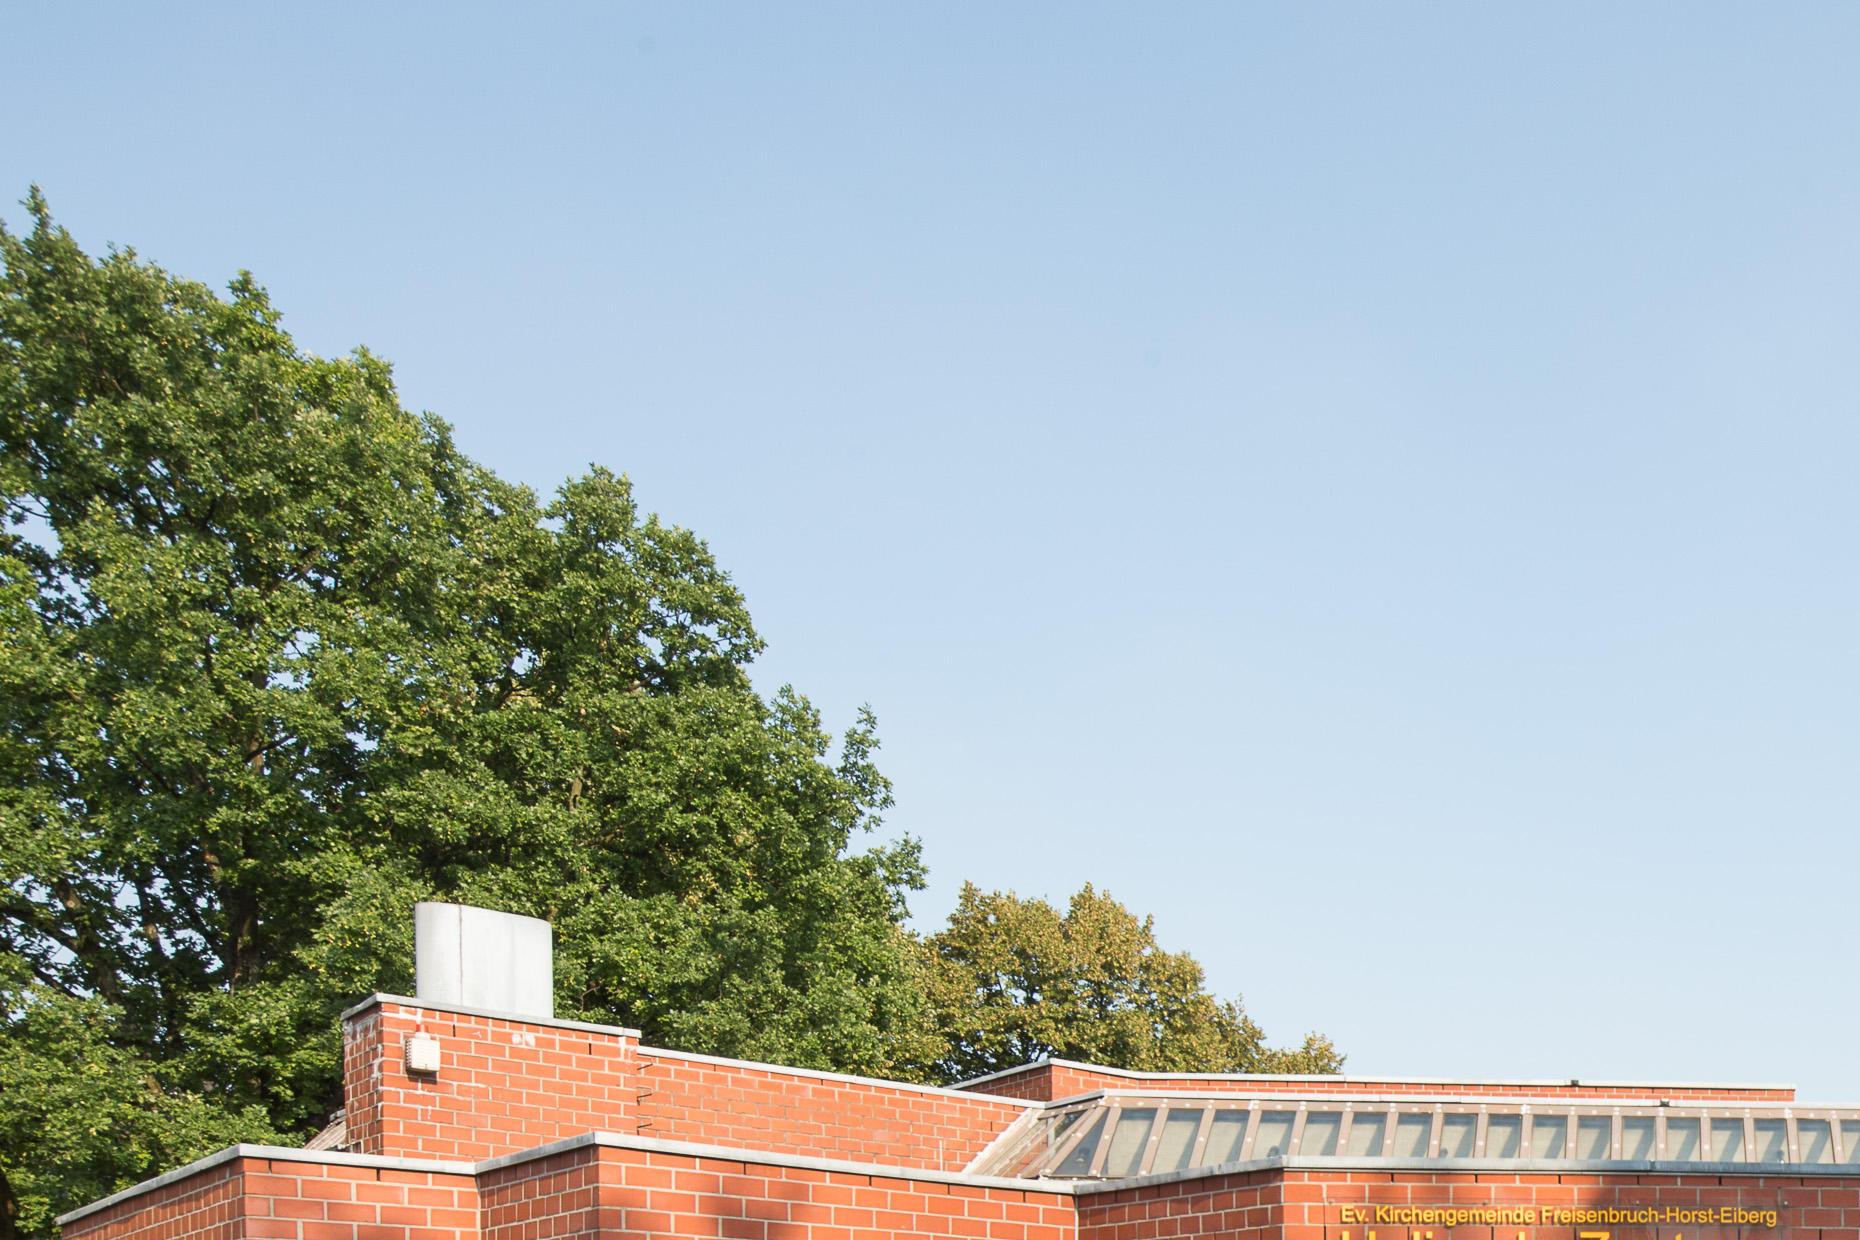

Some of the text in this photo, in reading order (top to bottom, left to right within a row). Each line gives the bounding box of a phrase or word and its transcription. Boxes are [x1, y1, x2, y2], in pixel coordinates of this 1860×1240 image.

[1341, 1205, 1777, 1227] Ev. Kirchengemeinde Freisenbruch-Horst-Eiberg
